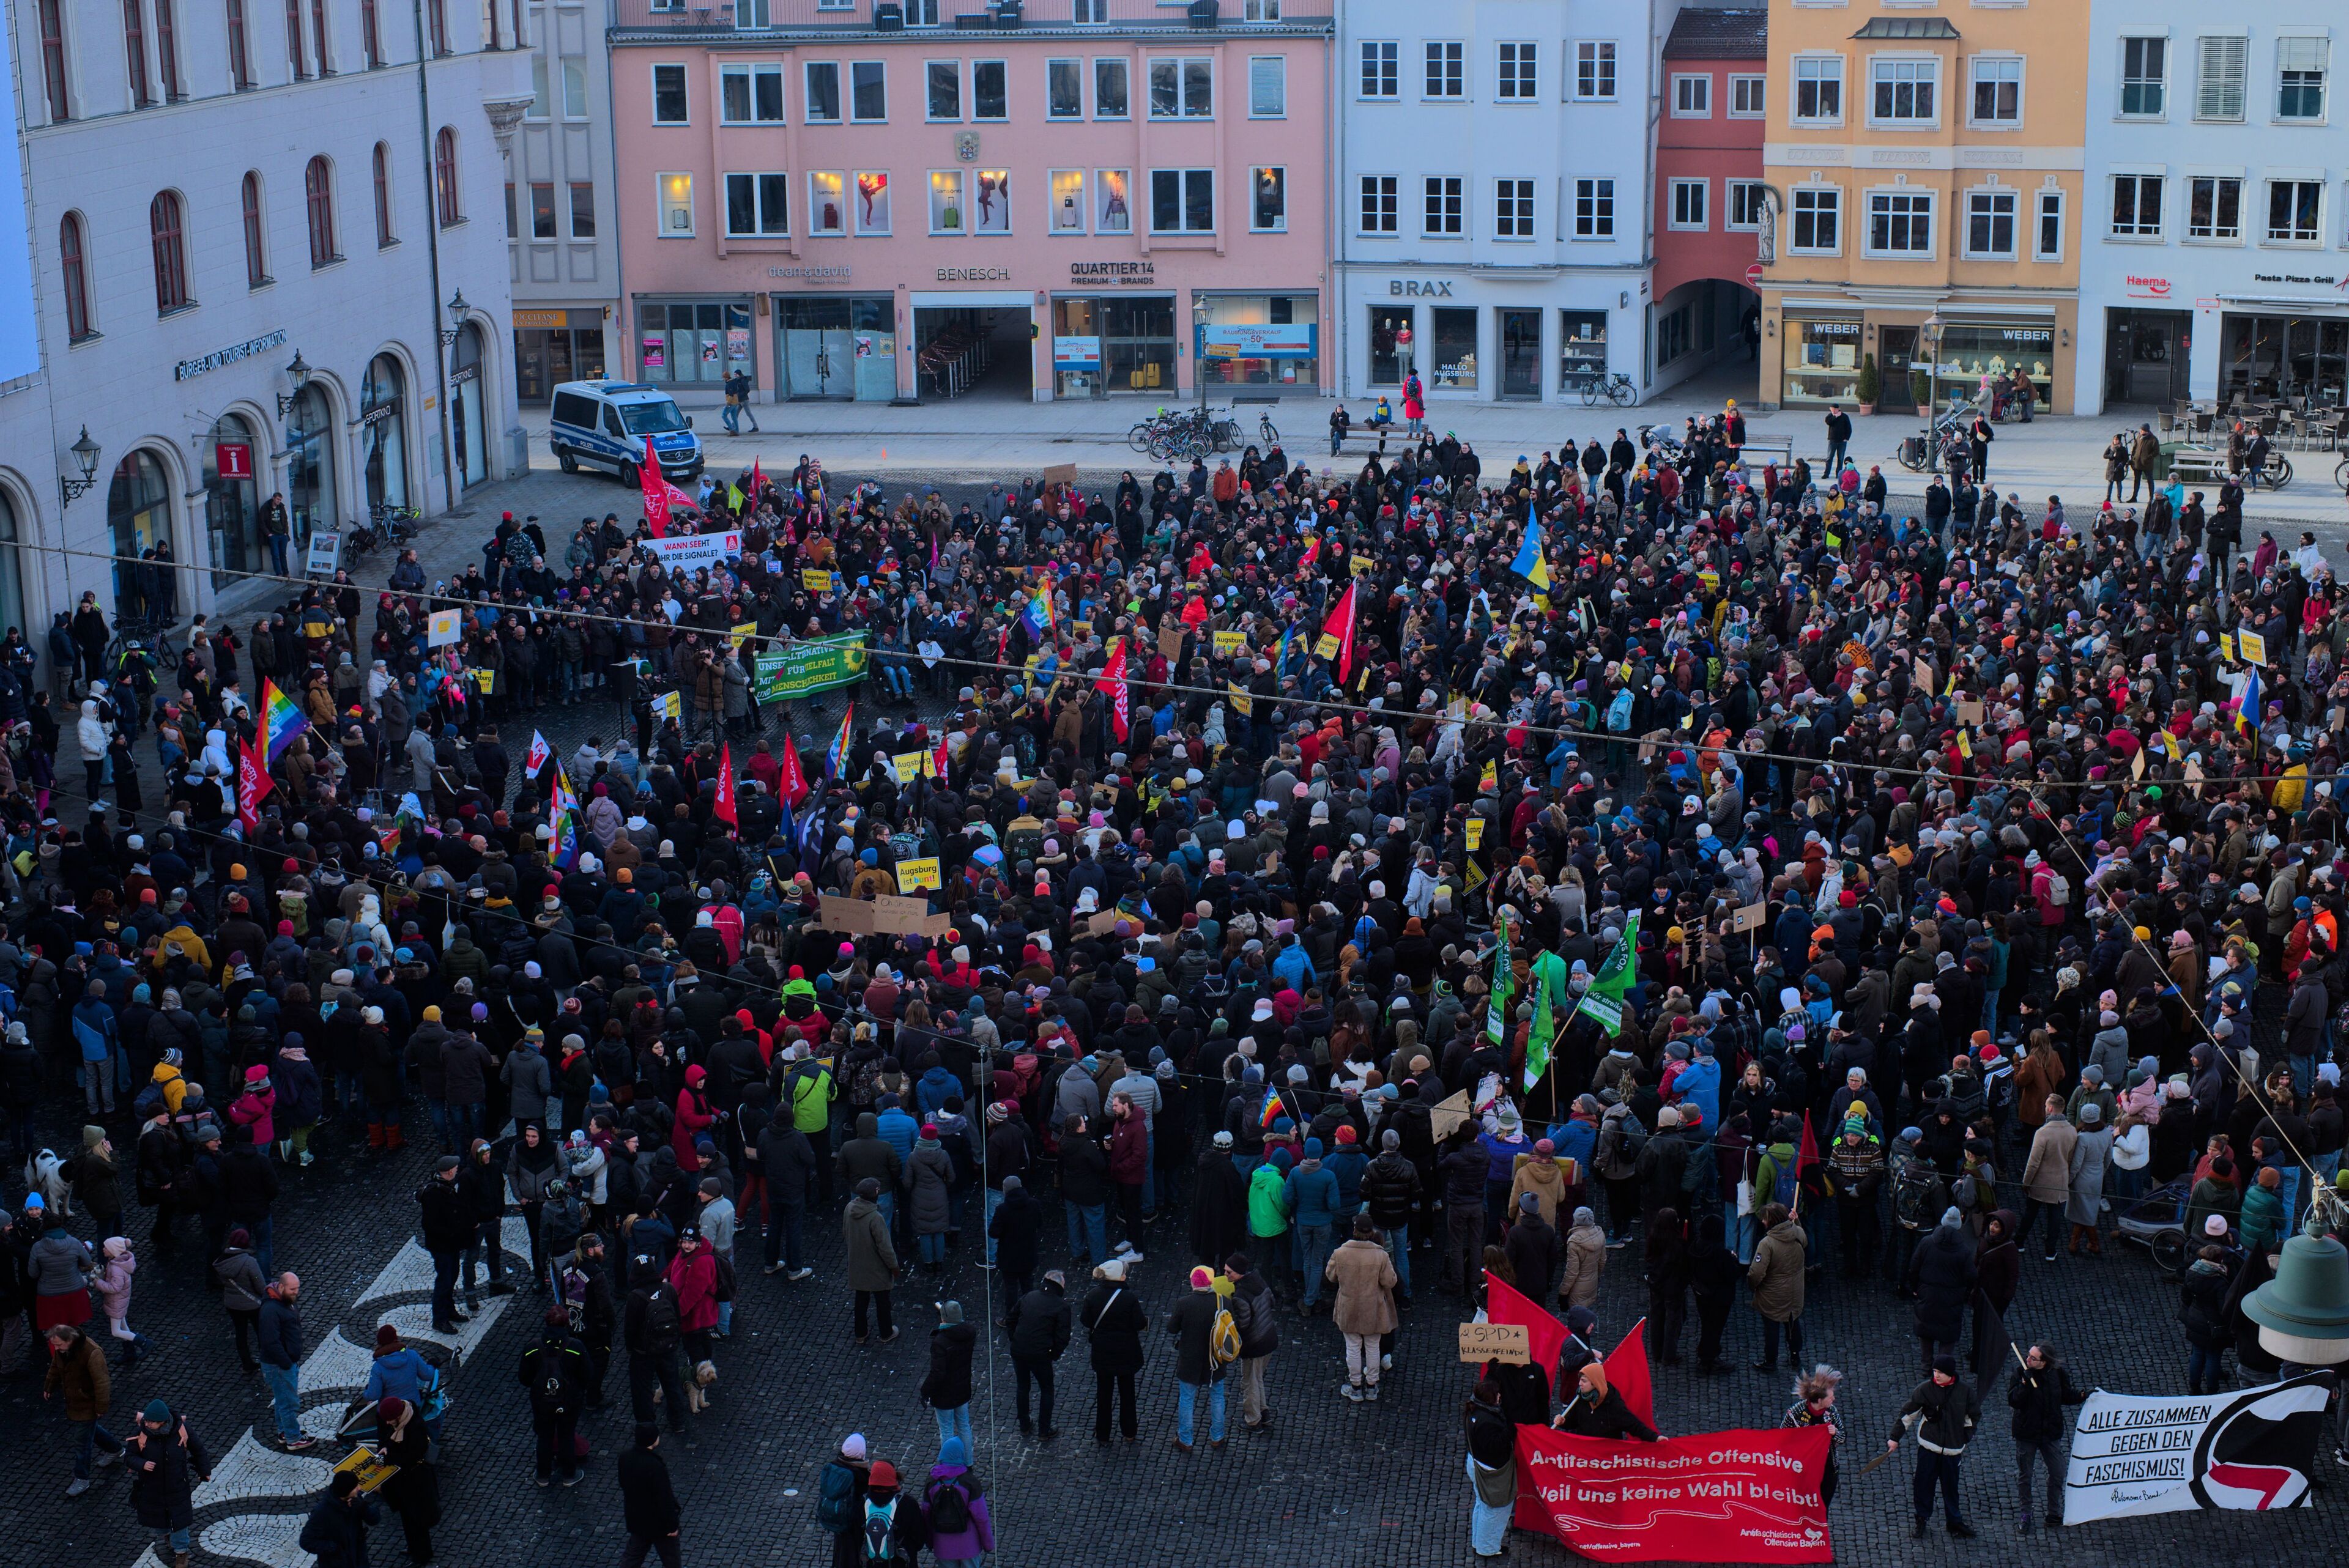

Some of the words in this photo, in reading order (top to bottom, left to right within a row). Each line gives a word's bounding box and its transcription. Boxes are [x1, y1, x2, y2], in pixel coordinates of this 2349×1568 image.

[769, 265, 801, 276] dean
[815, 265, 851, 276] david
[1071, 262, 1138, 275] QUARTIER
[1141, 262, 1154, 274] 14
[1390, 280, 1452, 296] BRAX
[1814, 324, 1859, 333] WEBER
[2003, 330, 2049, 340] WEBER
[580, 440, 594, 449] POLIZEI
[664, 542, 688, 550] WANN
[689, 539, 710, 548] SEEHT
[672, 552, 683, 561] DIE
[685, 549, 718, 560] SIGNALE?
[1321, 638, 1338, 649] Augsburg
[787, 664, 805, 675] FÜR
[804, 657, 836, 671] IELFALT
[757, 687, 771, 698] UND
[900, 865, 937, 876] Augsburg
[914, 875, 935, 884] bunt!
[1615, 954, 1628, 971] FOR
[1589, 990, 1601, 1000] Wir
[1475, 1327, 1510, 1342] SPD
[1461, 1345, 1526, 1356] KLASSENFEINDE
[2088, 1410, 2120, 1430] ALLE
[2125, 1405, 2212, 1426] ZUSAMMEN
[2111, 1432, 2157, 1453] GEGEN
[2162, 1430, 2194, 1449] DEN
[1531, 1450, 1702, 1470] Antifaschistische
[1709, 1449, 1804, 1474] Offensive
[2086, 1457, 2185, 1484] FASCHISMUS!
[1577, 1487, 1616, 1502] uns
[1622, 1484, 1682, 1500] keine
[1687, 1480, 1743, 1498] Wahl
[1749, 1481, 1819, 1508] bleibt!
[1740, 1528, 1802, 1539] Antifaschistische
[1764, 1539, 1798, 1547] Offensive
[1800, 1539, 1826, 1548] Bayern
